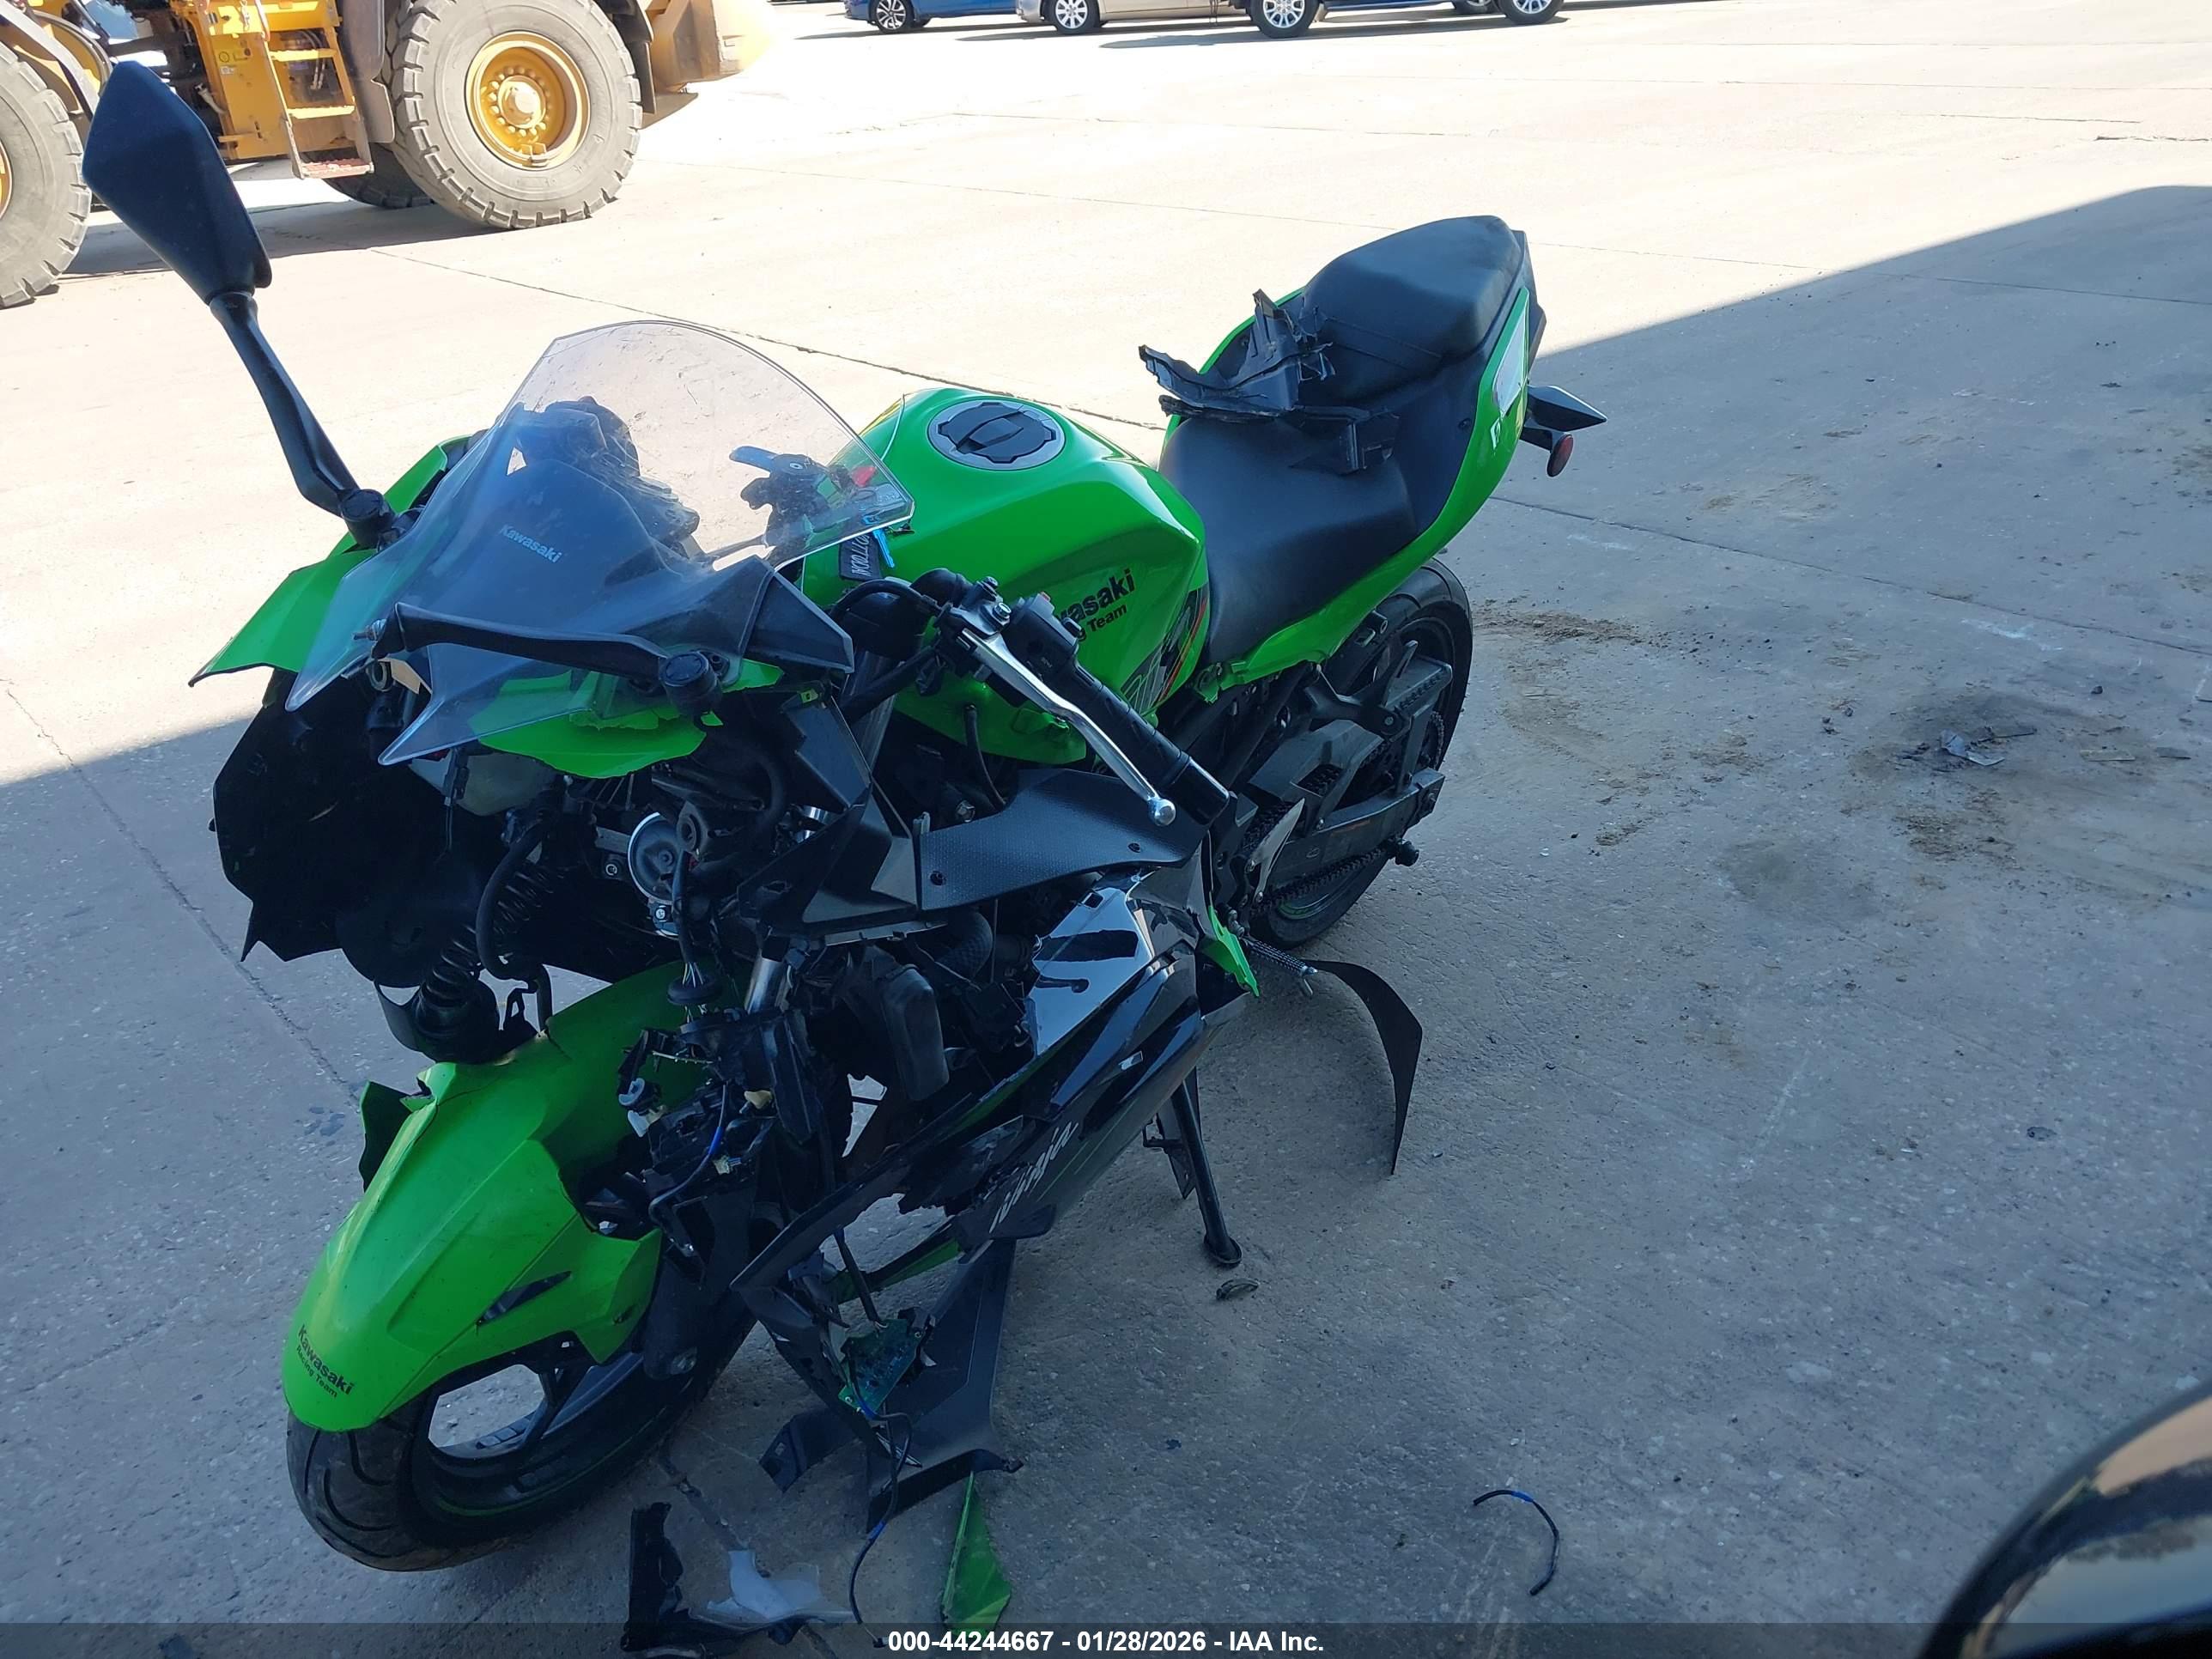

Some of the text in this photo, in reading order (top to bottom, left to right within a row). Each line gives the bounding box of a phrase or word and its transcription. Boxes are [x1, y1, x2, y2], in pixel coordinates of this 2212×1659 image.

[499, 524, 562, 563] Kawasaki
[1060, 568, 1135, 622] asaki
[1086, 604, 1127, 632] Team
[296, 1345, 338, 1398] Racing Team
[298, 1323, 355, 1395] Kawasaki
